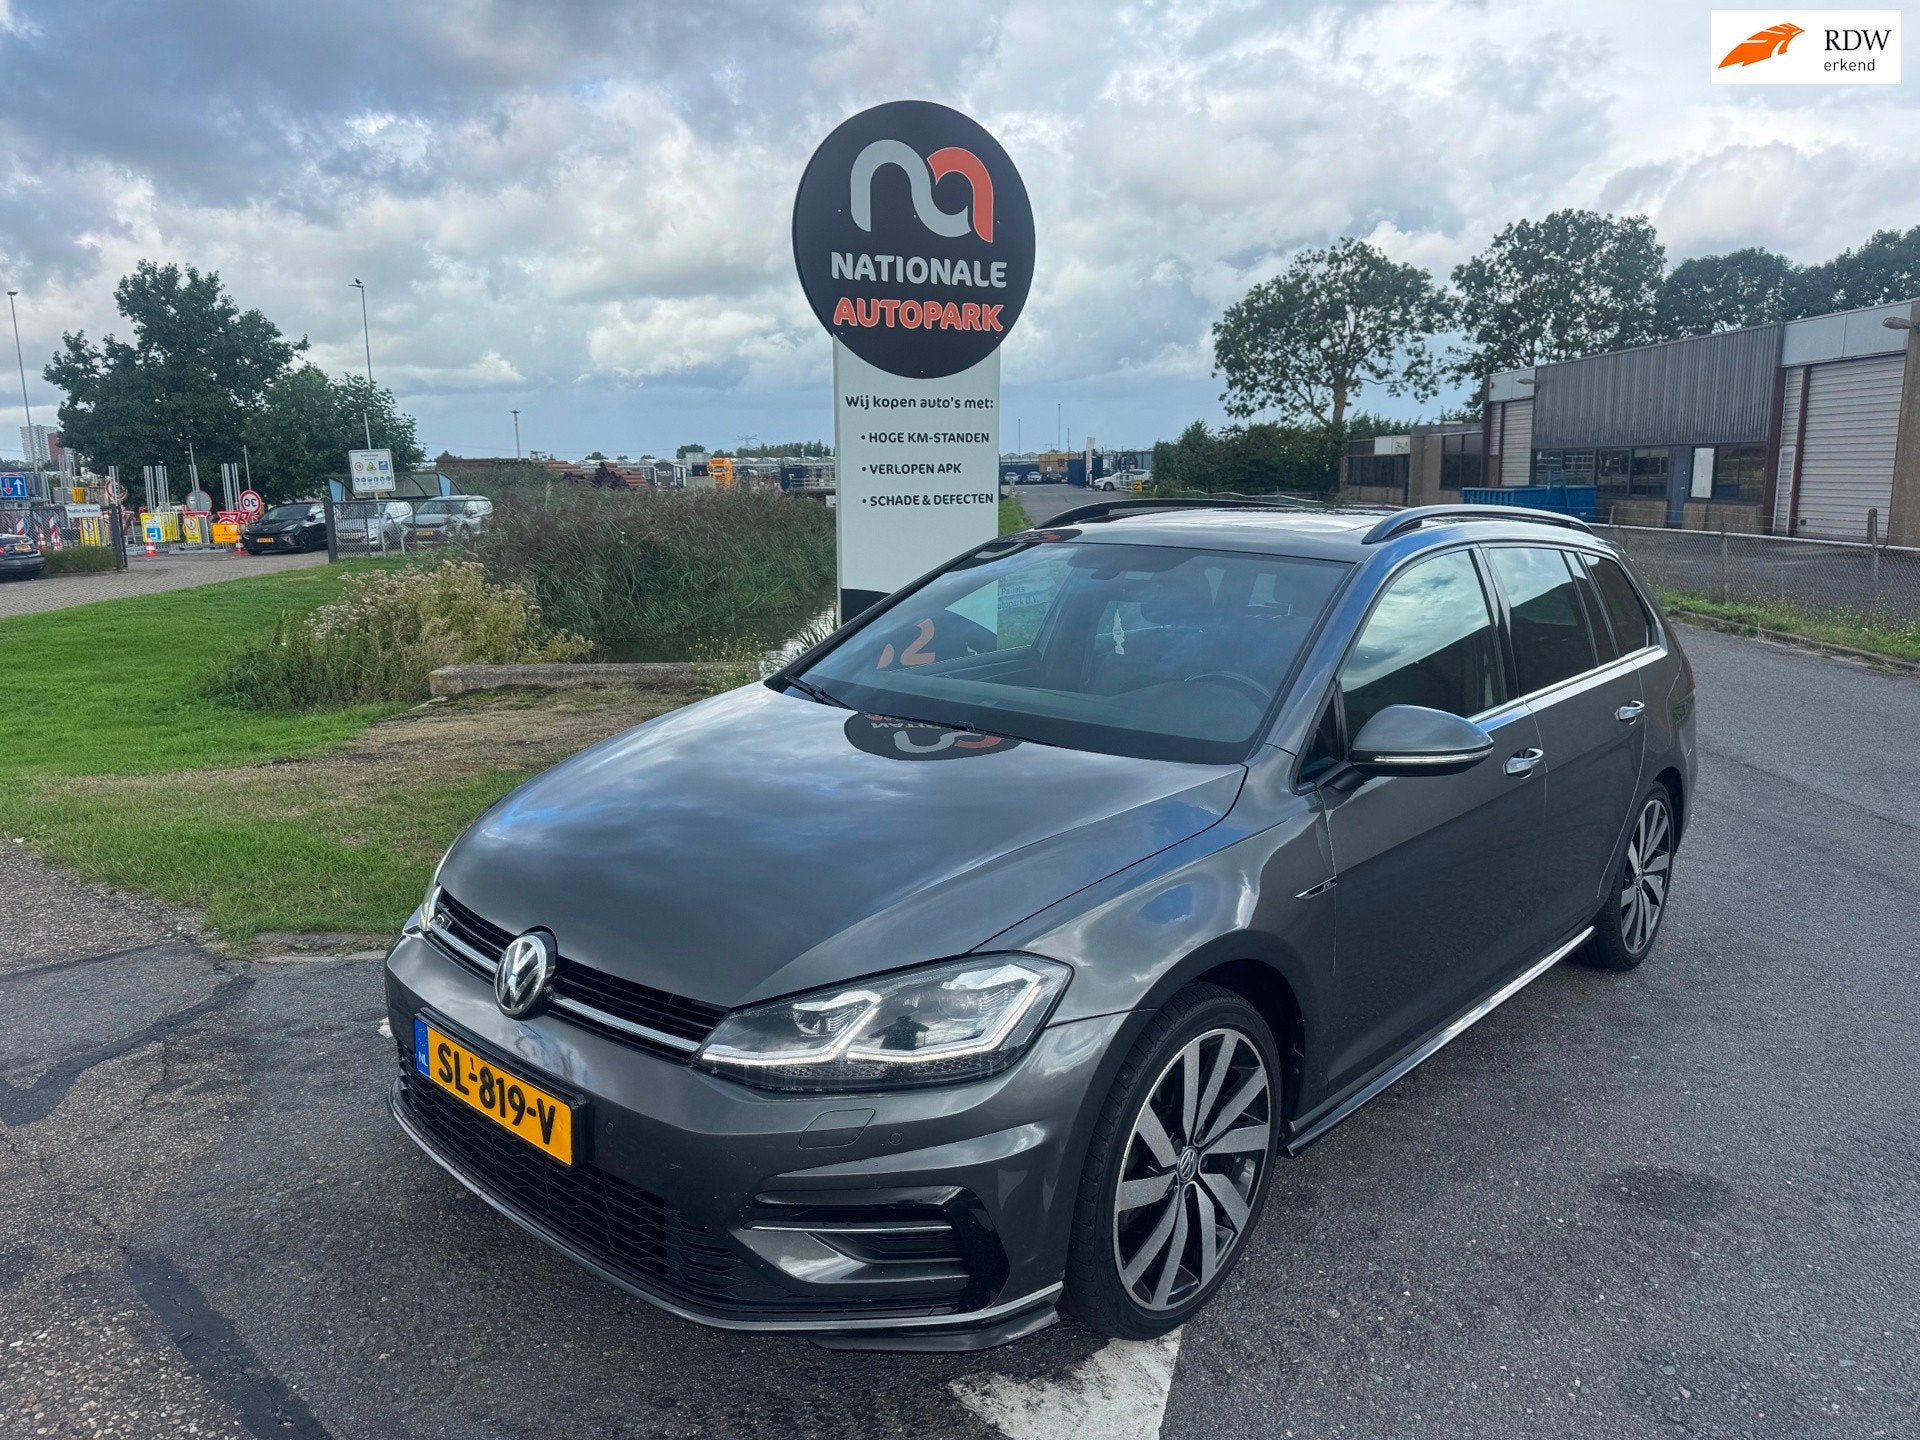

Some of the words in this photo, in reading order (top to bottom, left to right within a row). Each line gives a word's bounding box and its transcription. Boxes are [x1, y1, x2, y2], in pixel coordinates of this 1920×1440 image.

[831, 251, 1007, 288] NATIONALE
[833, 297, 1004, 331] AUTOPARK
[845, 395, 869, 410] Wij
[873, 396, 916, 410] kopen
[920, 397, 961, 409] auto's
[964, 398, 994, 409] met:
[869, 432, 904, 443] HOGE
[908, 432, 990, 443] KM-STANDEN
[869, 463, 935, 475] VERLOPEN
[937, 463, 962, 474] APK
[870, 495, 920, 506] SCHADE
[919, 494, 931, 505] &
[933, 493, 994, 505] DEFECTEN
[418, 1051, 428, 1067] NL
[437, 1042, 556, 1145] SL-819-V
